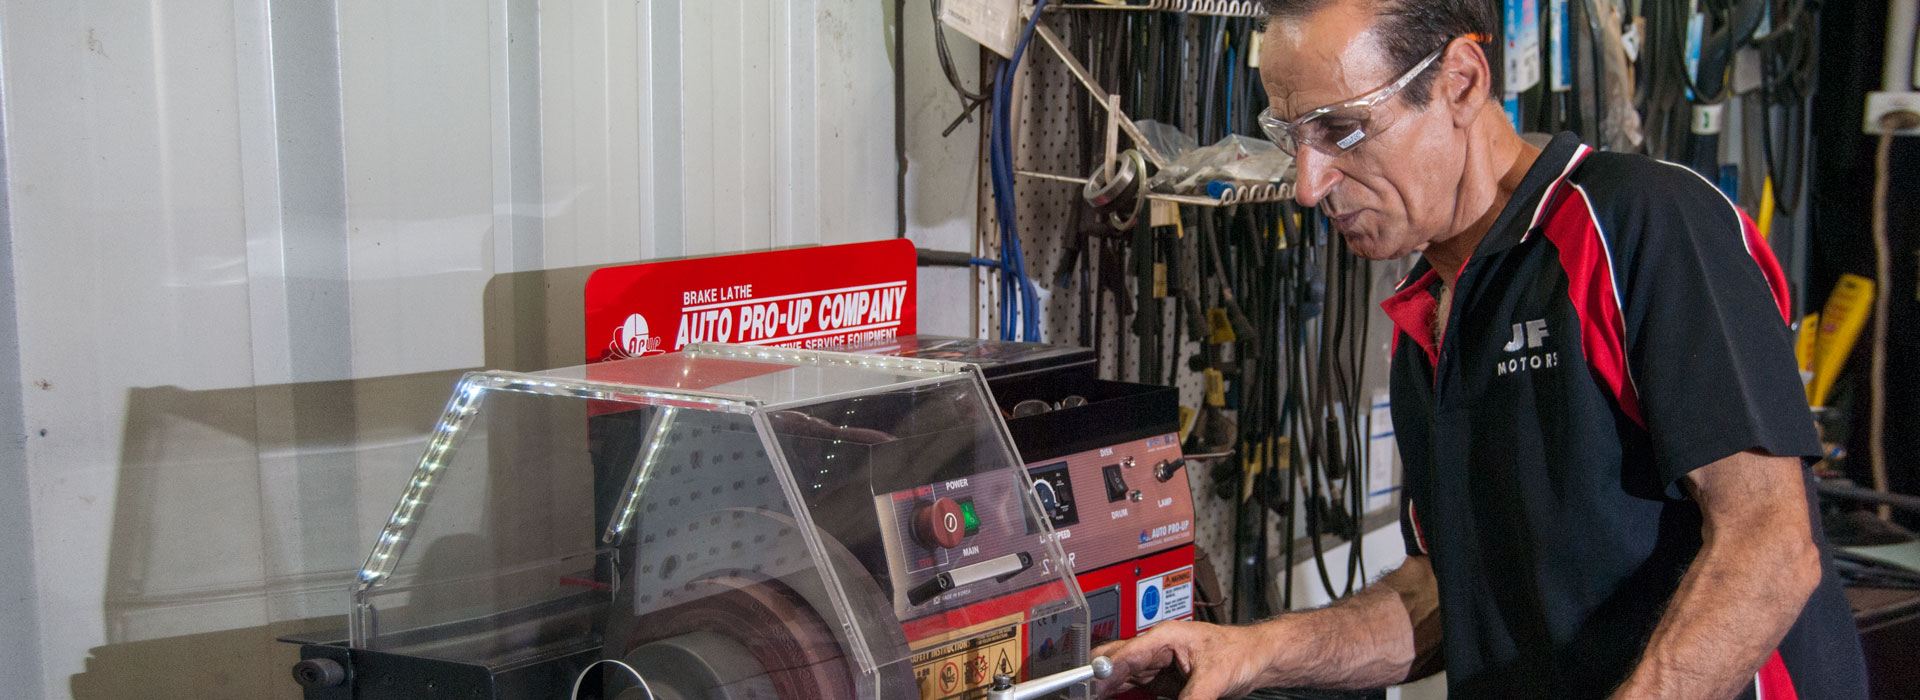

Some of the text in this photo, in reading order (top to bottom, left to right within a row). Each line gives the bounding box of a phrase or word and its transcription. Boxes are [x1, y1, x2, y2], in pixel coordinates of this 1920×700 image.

[683, 284, 753, 305] BRAKE LATHE
[675, 286, 907, 351] AUTO PRO-UP COMPANY
[806, 334, 845, 349] SERVICE
[849, 328, 898, 347] EQUIPMENT
[1503, 319, 1550, 352] JF
[1497, 352, 1558, 376] MOTORS
[1100, 447, 1113, 457] DISK
[945, 479, 968, 491] POWER
[1157, 497, 1172, 508] LAMP
[1111, 508, 1128, 520] DRUM
[1151, 520, 1190, 538] AUTO PRO-UP
[962, 545, 979, 557] MAIN
